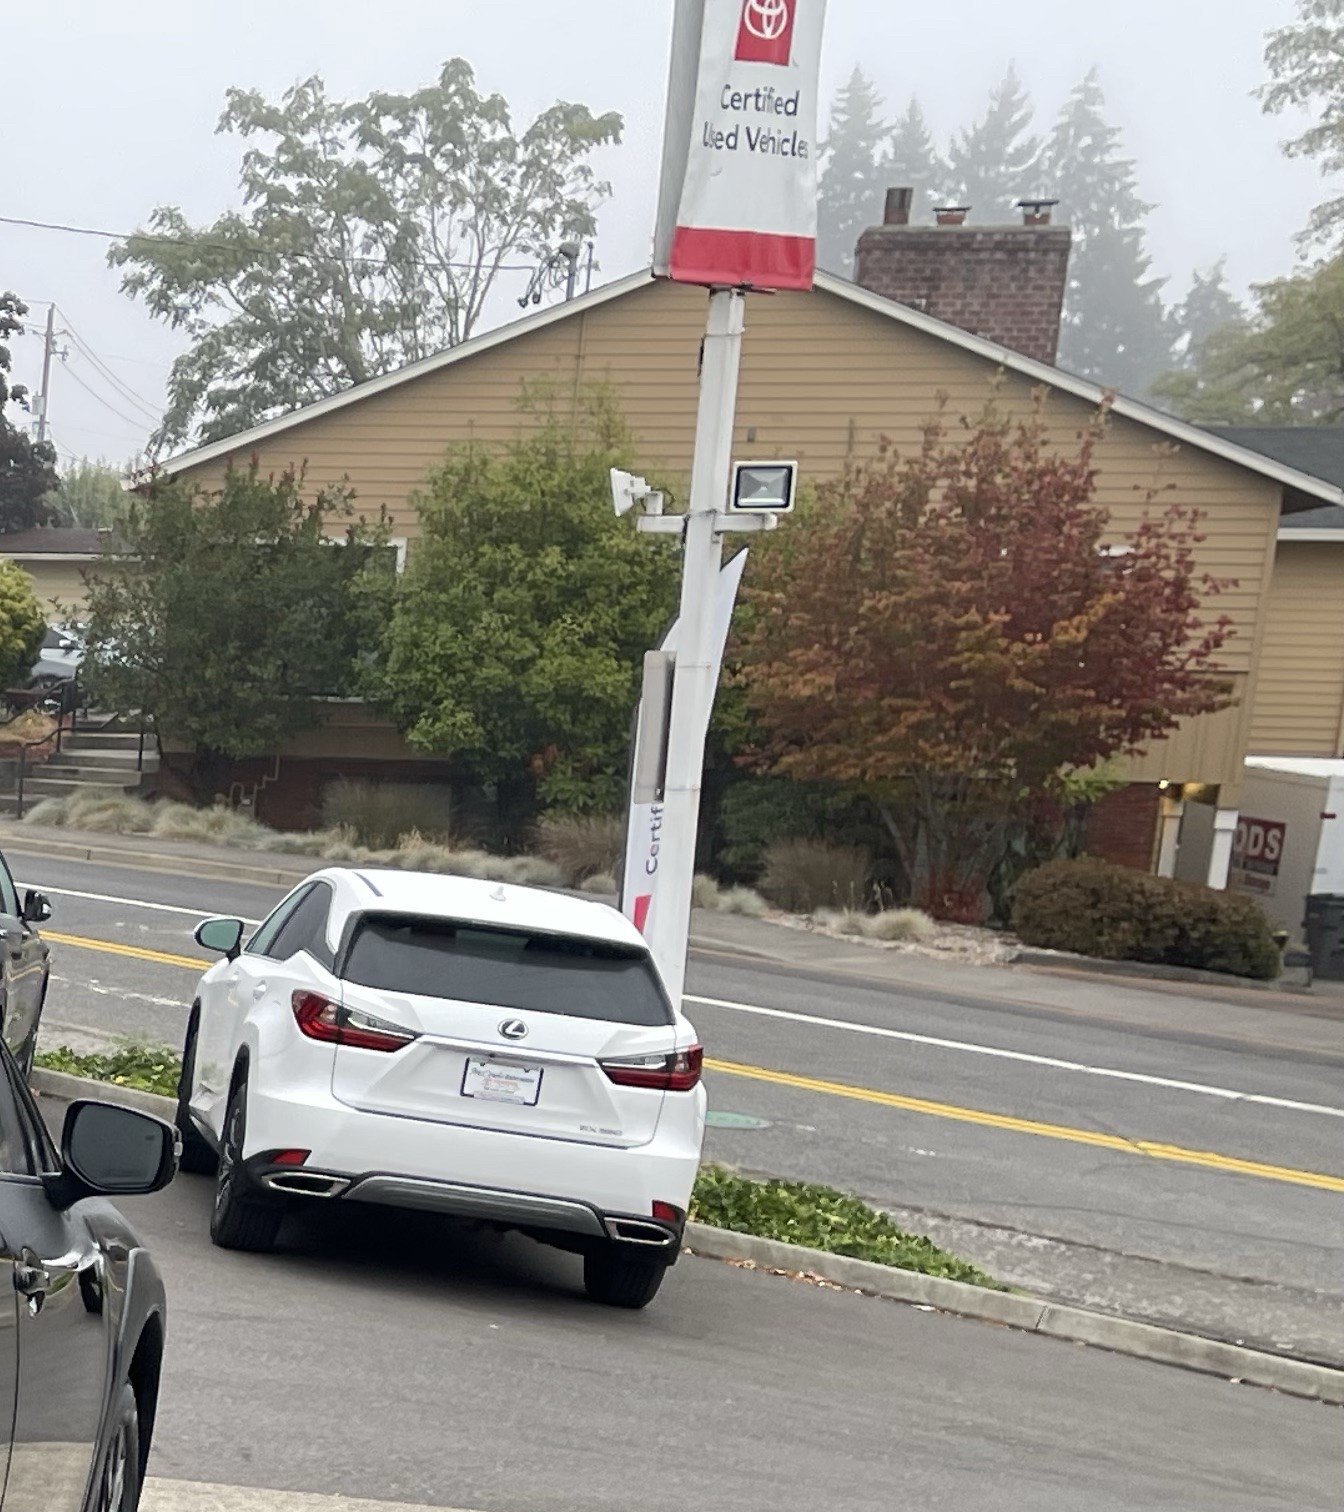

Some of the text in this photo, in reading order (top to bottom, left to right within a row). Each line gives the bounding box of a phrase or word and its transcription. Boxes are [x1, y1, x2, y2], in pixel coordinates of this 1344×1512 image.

[720, 84, 801, 117] Certified
[645, 806, 663, 875] Certif
[1233, 820, 1282, 861] ODS
